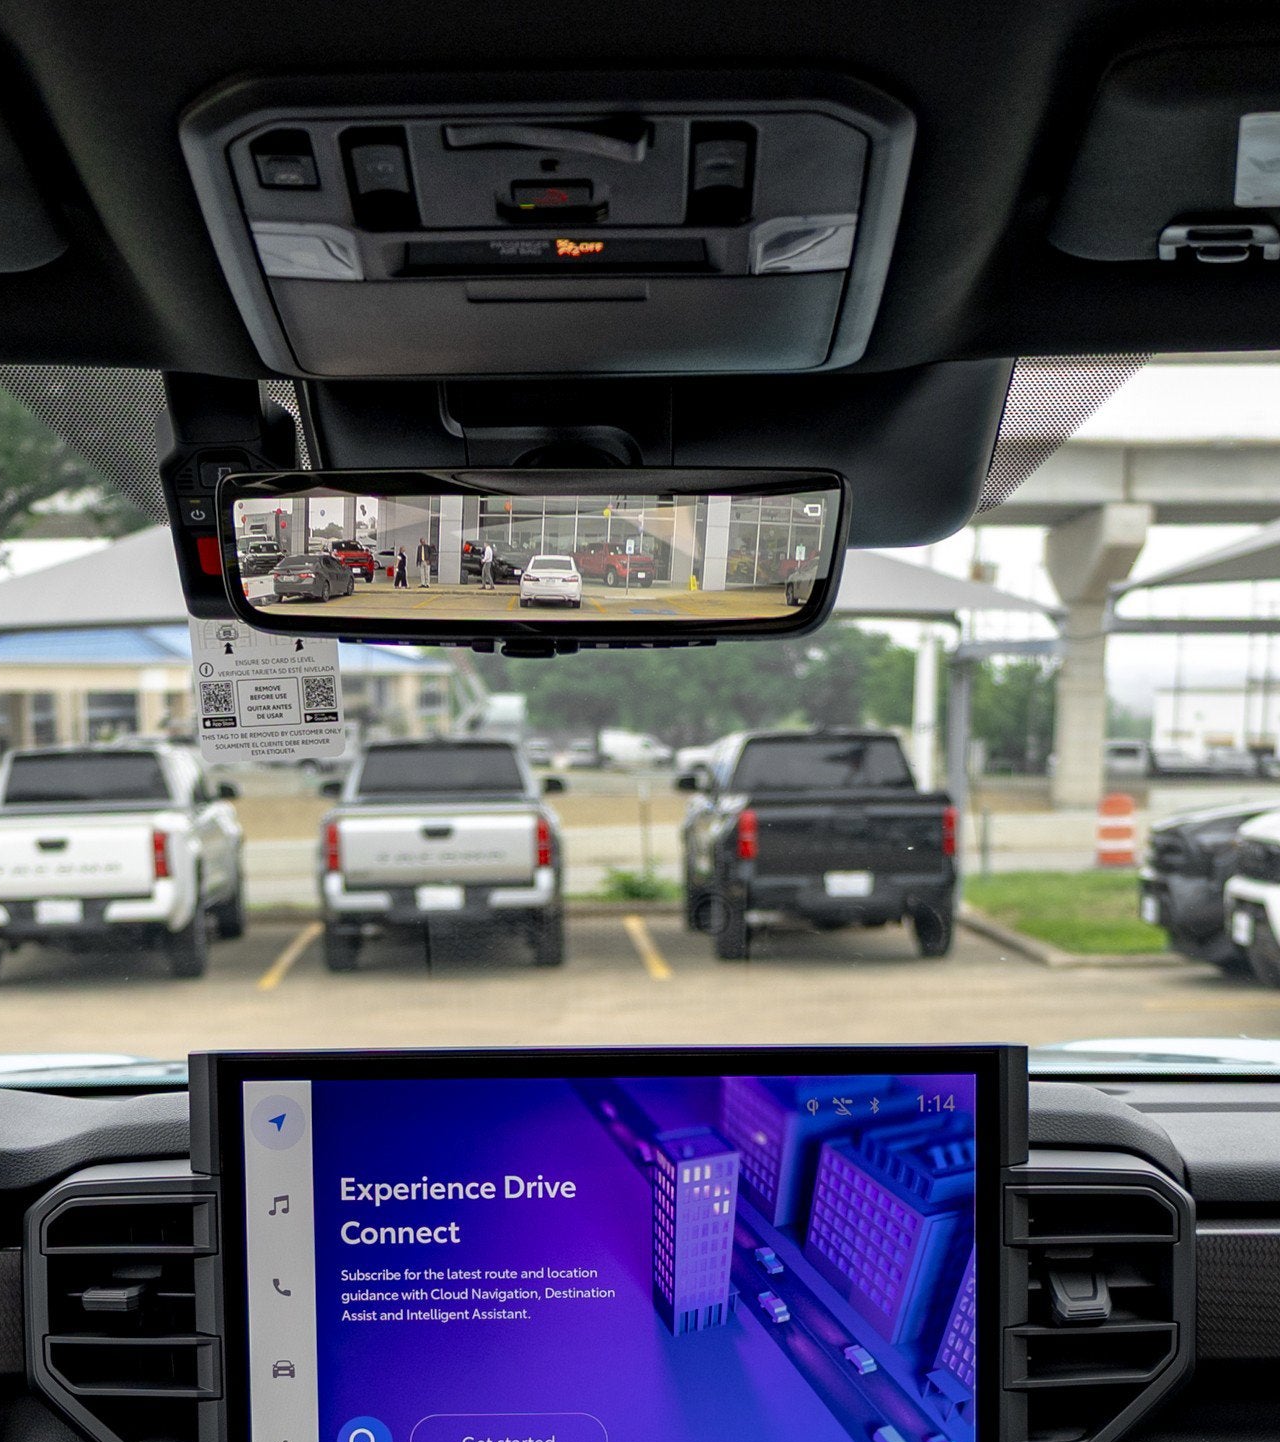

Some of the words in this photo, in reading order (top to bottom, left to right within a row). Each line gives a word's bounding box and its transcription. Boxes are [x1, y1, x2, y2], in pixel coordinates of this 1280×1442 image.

[235, 659, 260, 667] ENSURE
[297, 656, 315, 664] LEVEL
[218, 669, 250, 678] VERIFIQUE
[251, 668, 277, 676] TARJETA
[288, 666, 303, 674] ESTÉ
[304, 665, 335, 673] NIVELADA
[250, 693, 274, 701] BEFORE
[275, 692, 287, 700] USE
[247, 704, 271, 712] QUITAR
[272, 703, 292, 711] ANTES
[289, 728, 324, 737] CUSTOMER
[215, 742, 251, 750] SOLAMENTE
[285, 739, 301, 747] DEBE
[916, 1094, 956, 1113] 1:14
[340, 1175, 496, 1207] Experience
[504, 1175, 577, 1199] Drive
[340, 1220, 461, 1245] Connect
[340, 1268, 402, 1282] Subscribe
[404, 1268, 422, 1281] for
[423, 1268, 445, 1281] the
[447, 1267, 482, 1280] latest
[484, 1269, 518, 1280] route
[521, 1267, 544, 1280] and
[547, 1266, 598, 1279] location
[341, 1289, 399, 1304] guidance
[401, 1288, 428, 1301] with
[430, 1288, 469, 1301] Cloud
[471, 1287, 542, 1303] Navigation,
[545, 1287, 616, 1299] Destination
[342, 1309, 377, 1322] Assist
[380, 1309, 404, 1321] and
[406, 1308, 470, 1323] Intelligent
[472, 1307, 531, 1320] Assistant.
